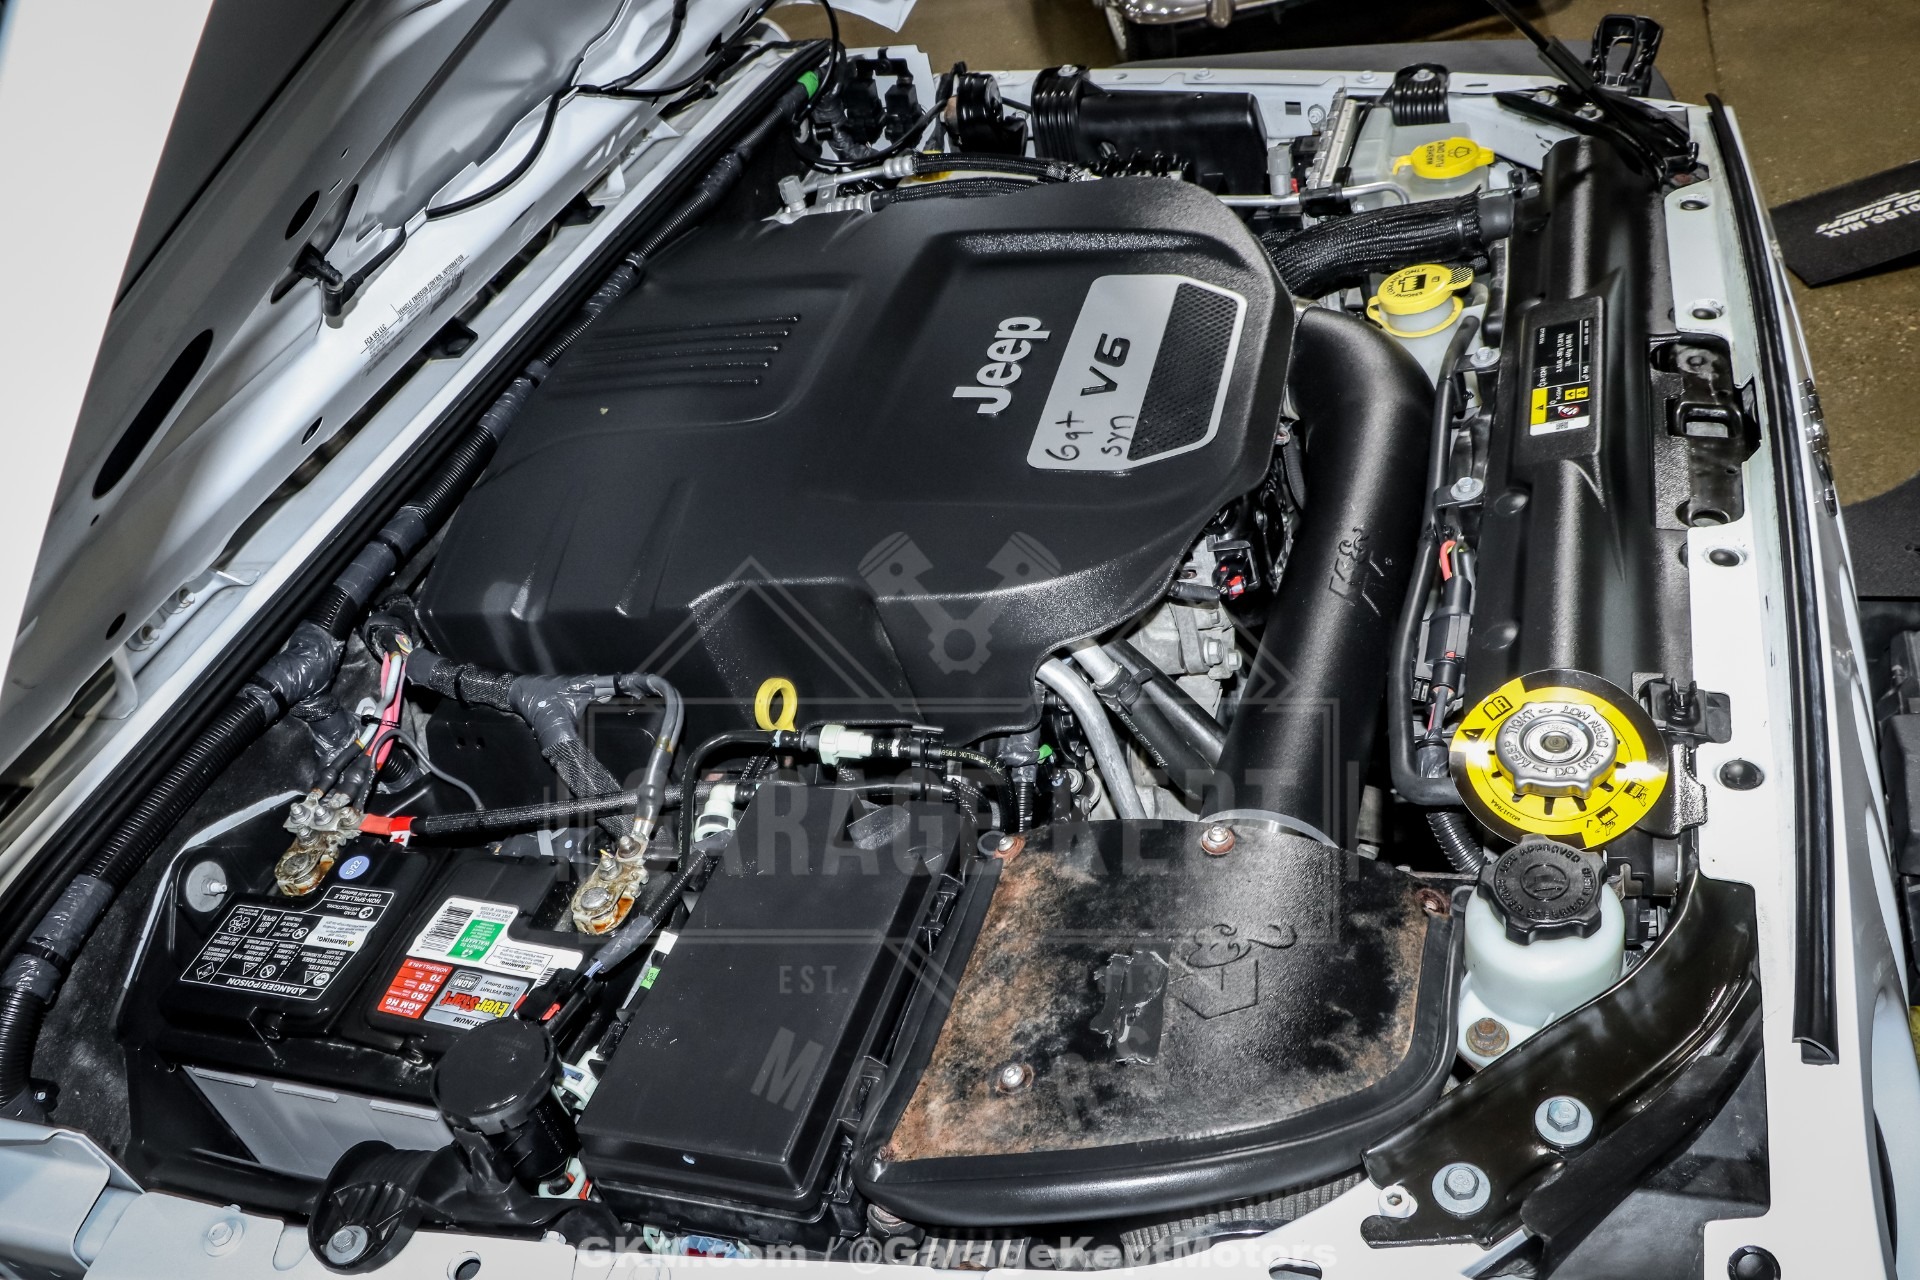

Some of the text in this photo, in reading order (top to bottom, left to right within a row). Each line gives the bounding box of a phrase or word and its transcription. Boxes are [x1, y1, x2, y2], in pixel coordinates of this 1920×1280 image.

[1816, 203, 1891, 233] RAMPS
[1822, 221, 1868, 238] MAX
[398, 301, 413, 316] VEHICLE
[412, 287, 429, 301] EMISSION
[427, 274, 443, 289] CONTROL
[442, 254, 465, 276] INFORMATION
[364, 324, 387, 346] FCA US LLC
[953, 317, 1050, 416] Jeep
[1080, 333, 1131, 396] V6
[1101, 415, 1135, 457] syn
[1505, 709, 1534, 736] TIGHT
[1555, 705, 1609, 777] DO NOT OPEN HOT
[1505, 741, 1529, 769] KEEP
[1520, 844, 1581, 863] APPROVED
[345, 859, 362, 875] 5/22
[332, 893, 381, 903] NON-SPILLABLE
[314, 935, 348, 945] WARNING:
[461, 937, 490, 946] WALMART
[407, 962, 448, 971] NONSPILLABLE
[226, 977, 299, 994] DANGER/POISON
[417, 982, 435, 991] 120
[428, 974, 442, 982] 70
[453, 978, 474, 987] AGM
[384, 997, 421, 1010] AGM H6
[409, 991, 429, 1001] 760
[437, 990, 512, 1016] EverStart
